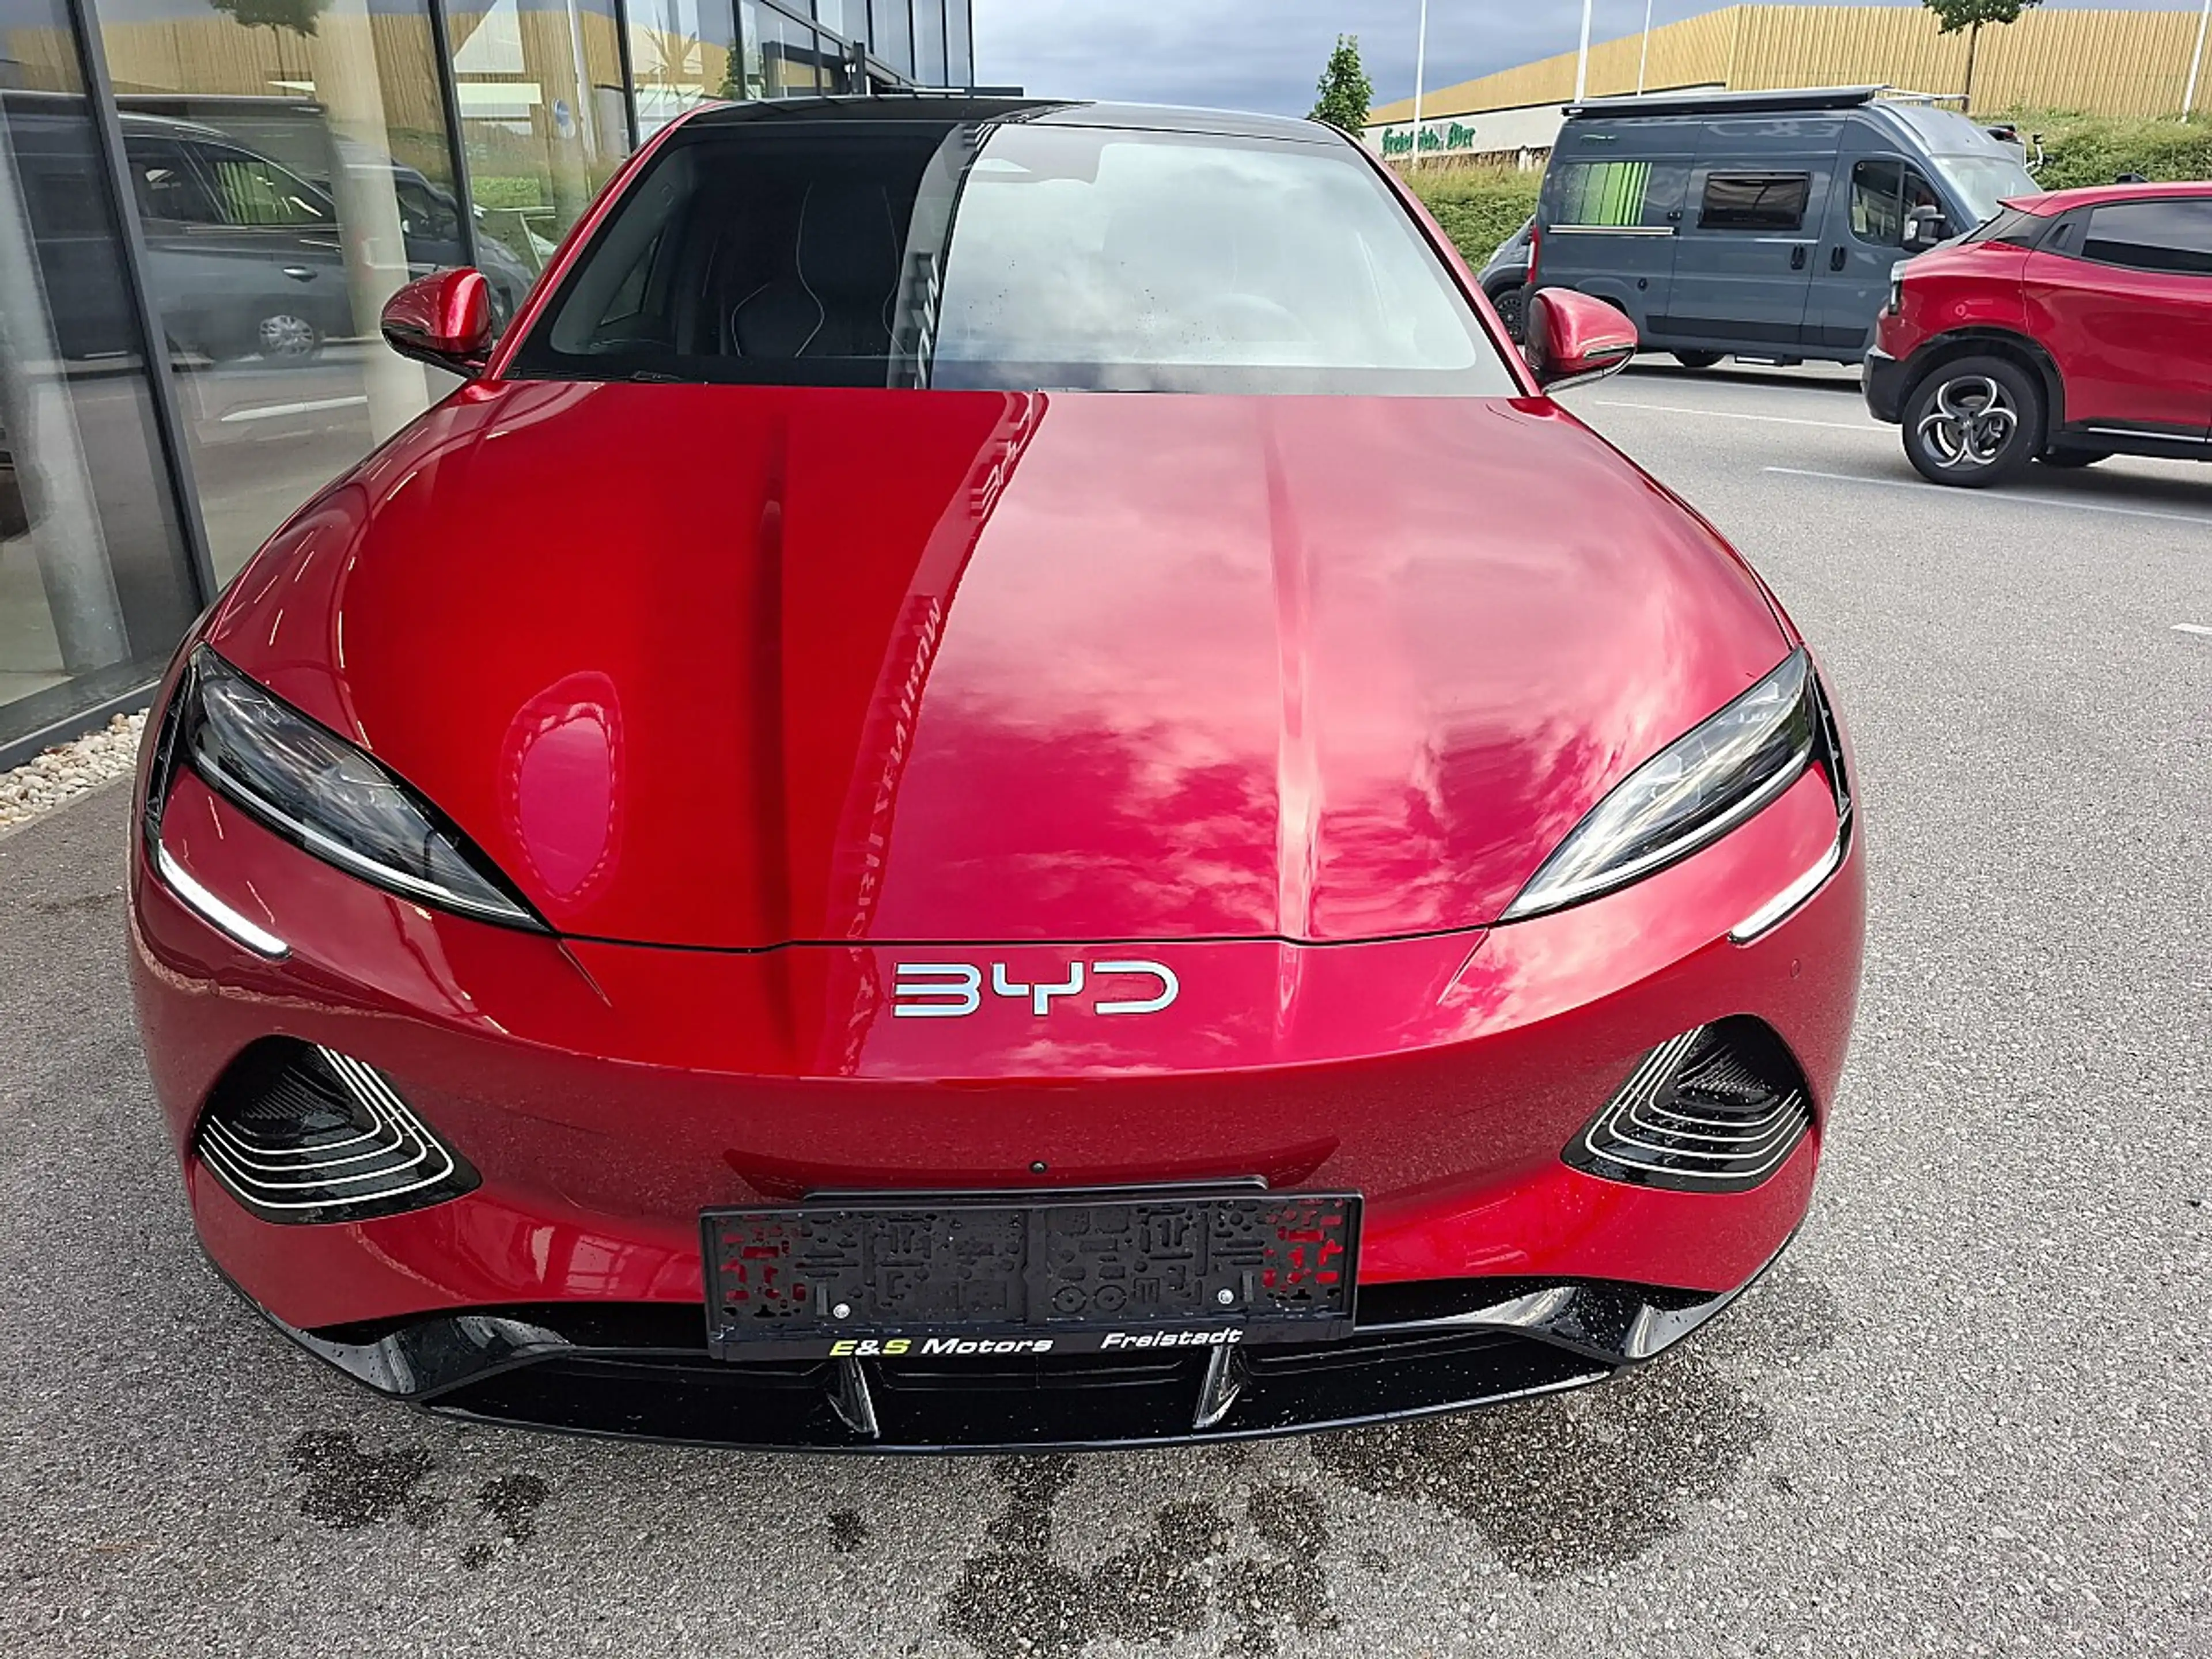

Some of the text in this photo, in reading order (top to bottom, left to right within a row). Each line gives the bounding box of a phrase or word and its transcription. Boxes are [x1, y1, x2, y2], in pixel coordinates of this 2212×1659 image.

[894, 961, 1179, 1017] BYD
[830, 1327, 1243, 1356] E&S Motors Freistadt
